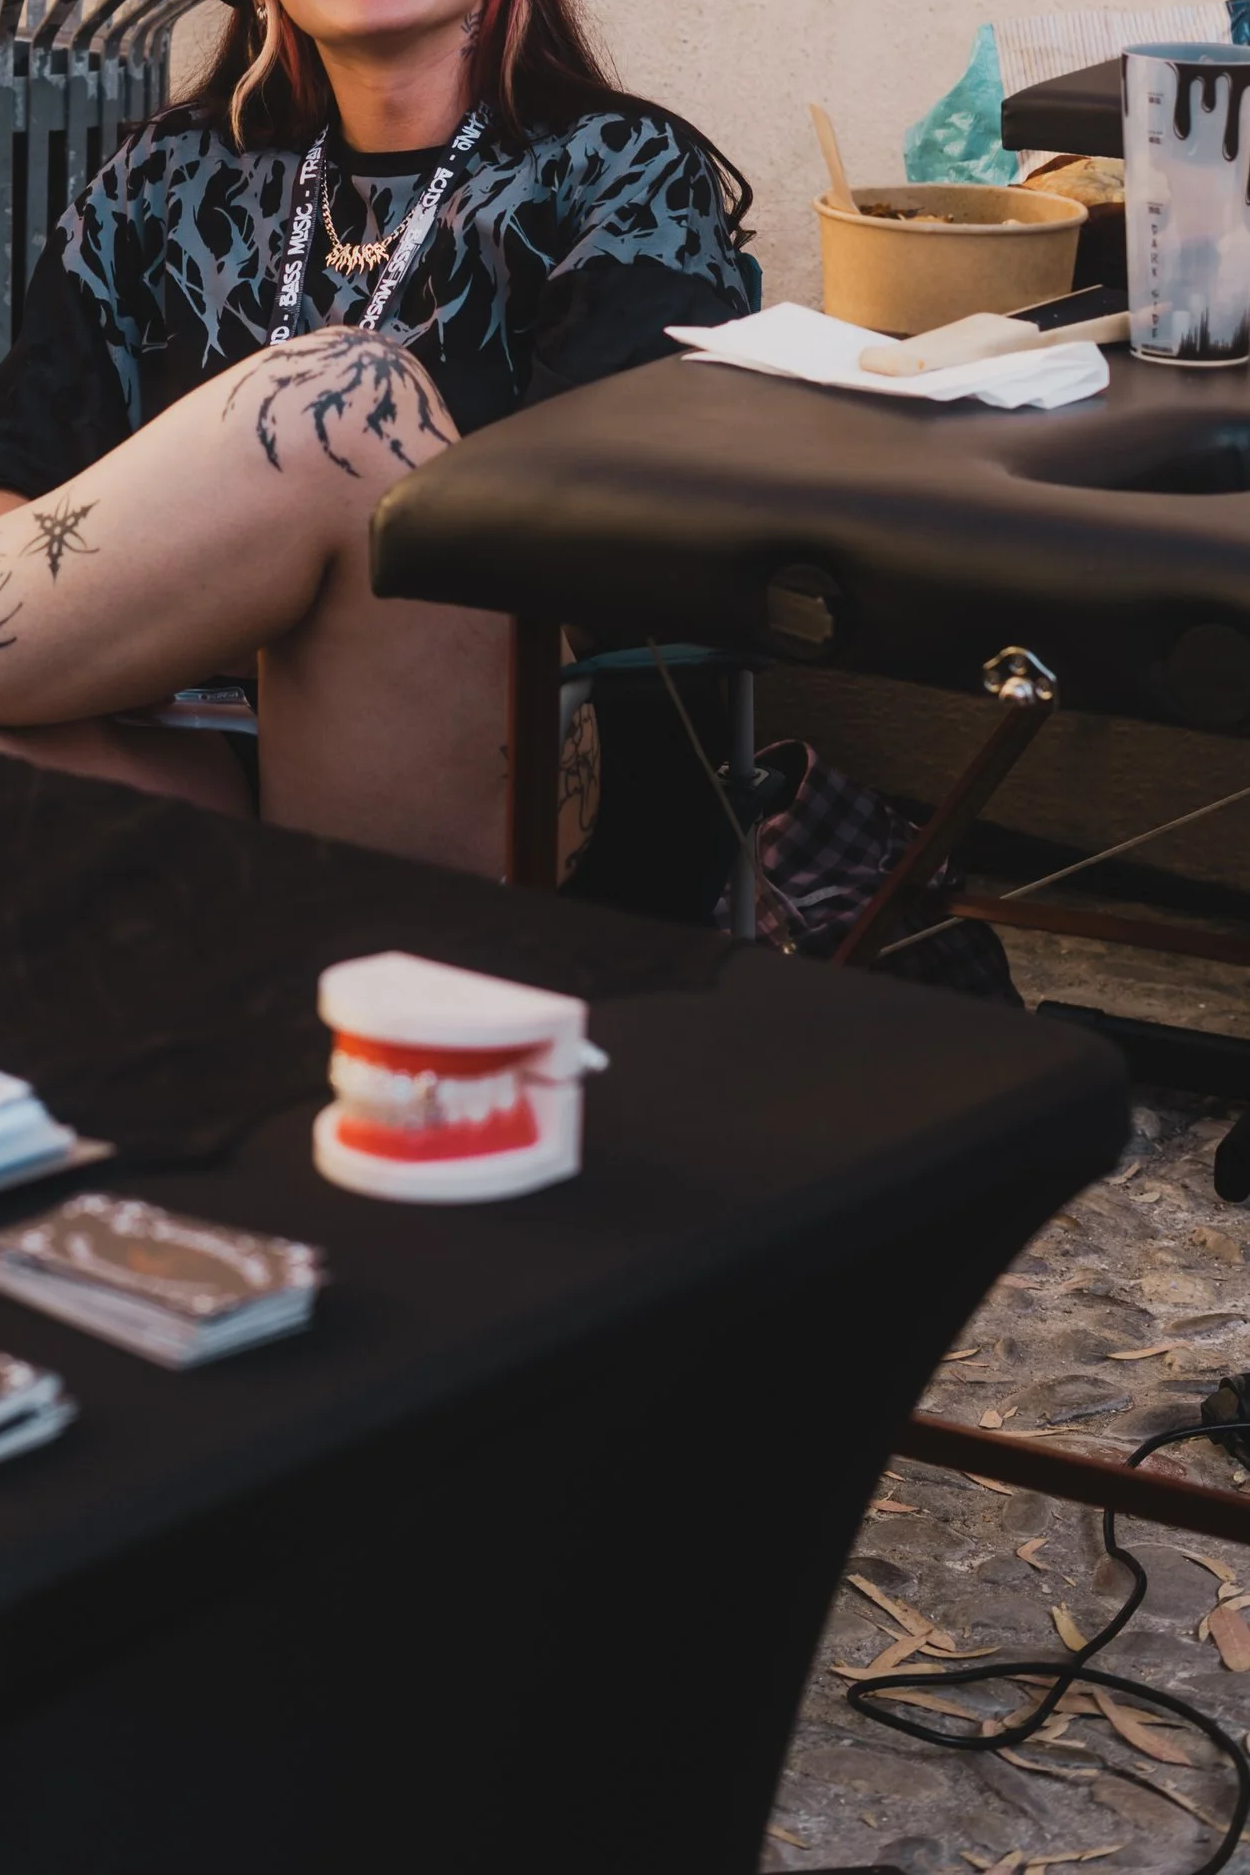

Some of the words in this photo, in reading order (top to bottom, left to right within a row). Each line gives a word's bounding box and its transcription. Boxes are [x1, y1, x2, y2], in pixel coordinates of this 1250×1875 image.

[287, 206, 314, 256] MUSIC
[278, 261, 302, 307] BASS
[359, 278, 397, 331] MUSIC
